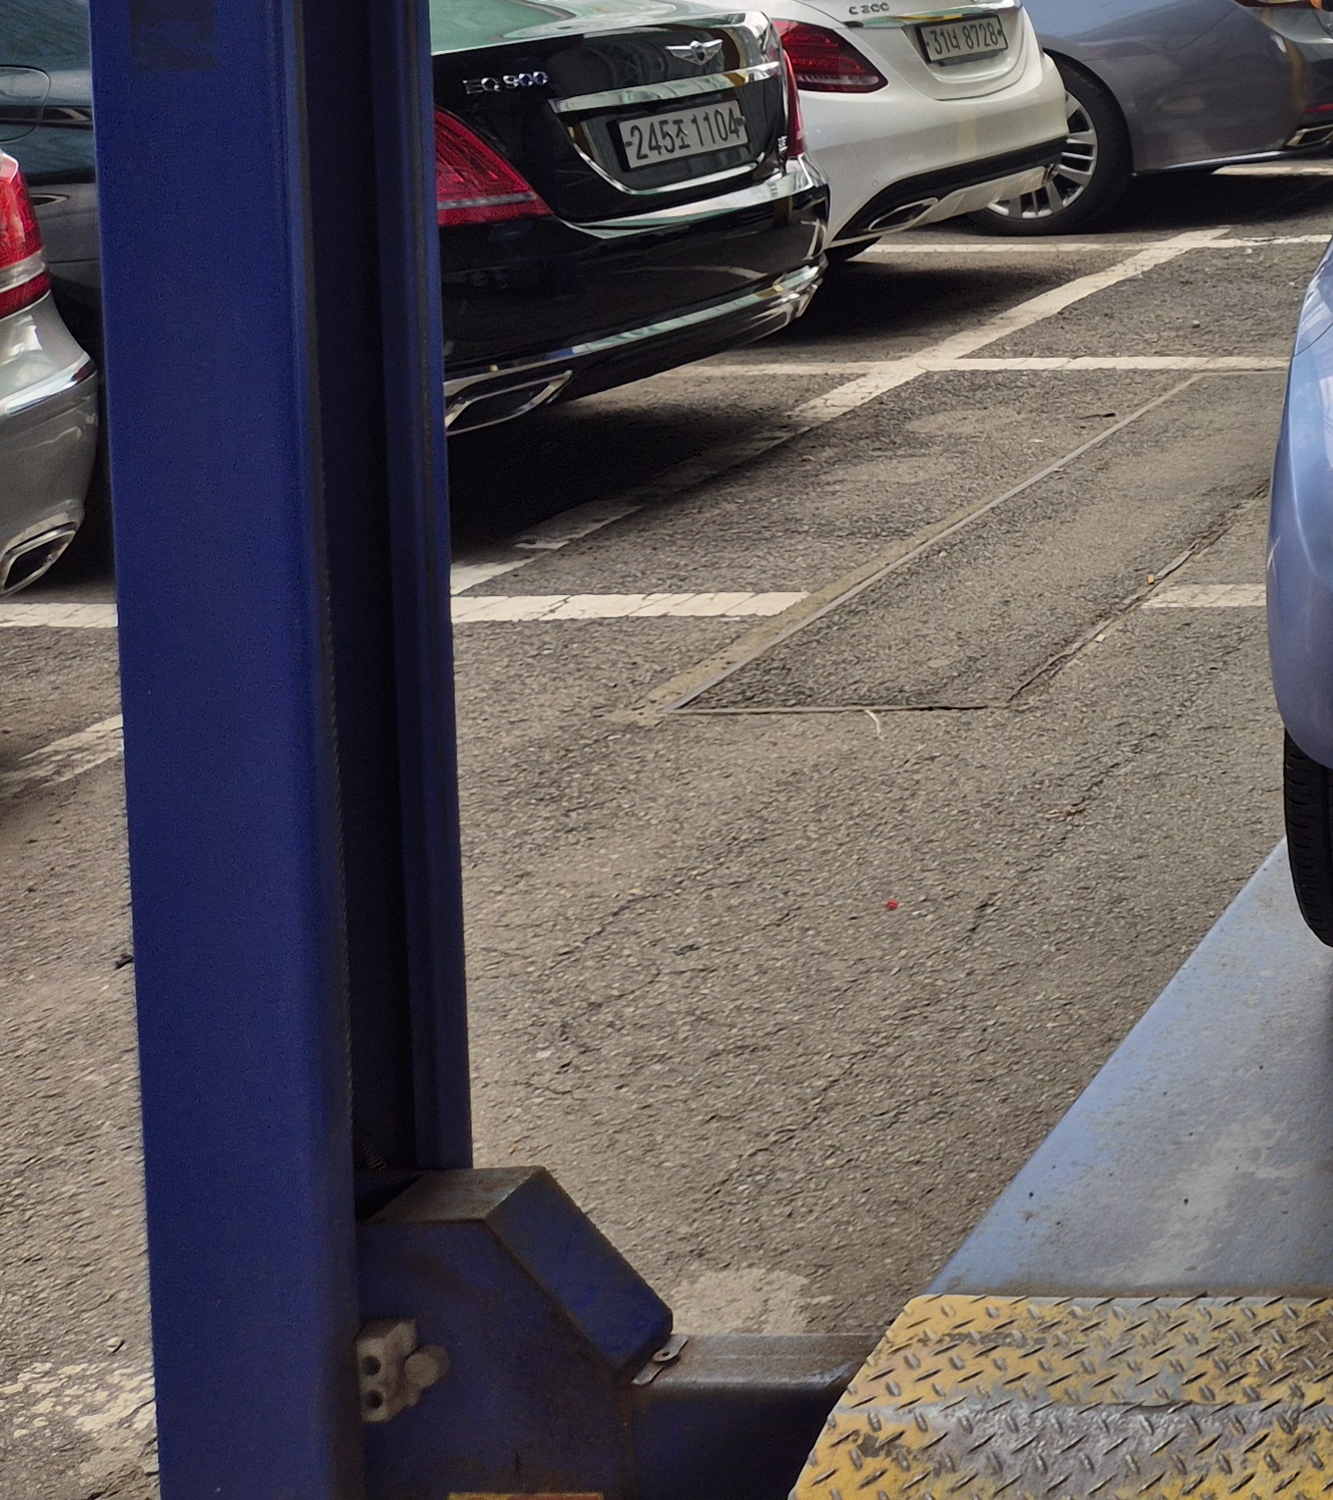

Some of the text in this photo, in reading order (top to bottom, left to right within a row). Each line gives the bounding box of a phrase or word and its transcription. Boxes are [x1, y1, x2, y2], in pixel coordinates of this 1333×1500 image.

[861, 2, 890, 14] 200
[962, 22, 999, 50] 8728
[462, 71, 548, 95] EQ 900
